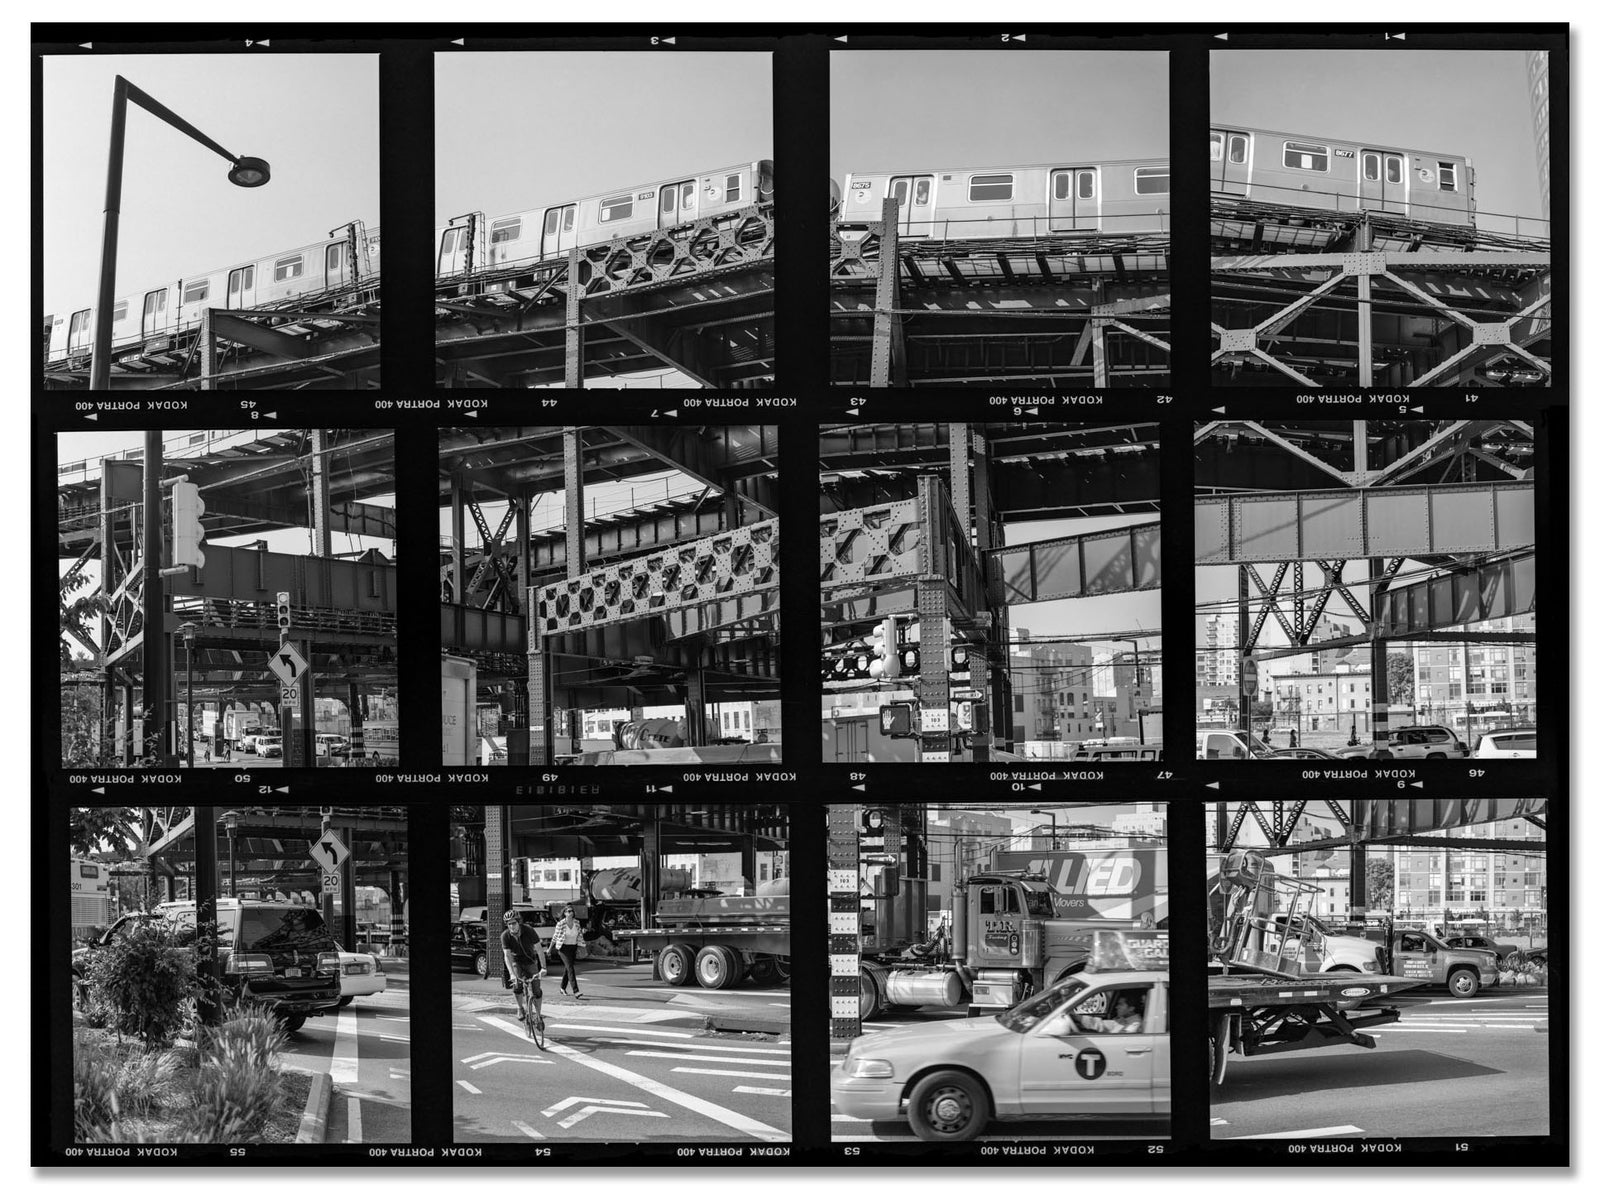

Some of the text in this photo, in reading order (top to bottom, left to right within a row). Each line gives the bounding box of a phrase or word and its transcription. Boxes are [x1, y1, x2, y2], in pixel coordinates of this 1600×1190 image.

[651, 37, 659, 45] 3
[1002, 34, 1009, 42] 2
[245, 39, 253, 47] 4
[542, 399, 557, 407] 44
[684, 399, 702, 407] 400
[756, 398, 796, 406] KODAK
[990, 396, 1102, 405] KODAK PORTRA 400
[1297, 395, 1409, 403] KODAK PORTRA 400
[76, 401, 187, 410] KODAK PORTRA 400
[396, 400, 440, 408] PORTRA
[448, 400, 487, 408] KODAK
[251, 411, 259, 419] 8
[1014, 407, 1021, 415] 6
[282, 688, 296, 699] 20
[683, 773, 796, 781] KODAK PORTRA 400
[850, 772, 866, 780] 48
[990, 772, 1008, 780] 400
[1012, 772, 1054, 780] PORTRA
[1157, 771, 1173, 779] 47
[1302, 770, 1415, 779] KODAK PORTRA 400
[1469, 769, 1485, 777] 46
[70, 775, 181, 783] KODAK PORTRA 400
[397, 774, 440, 782] PORTRA
[448, 774, 488, 782] KODAK
[1012, 783, 1025, 791] 10
[324, 876, 338, 886] 20
[1081, 1054, 1100, 1076] T
[844, 1147, 860, 1155] 53
[981, 1146, 1094, 1155] KODAK PORTRA 400
[1289, 1144, 1401, 1153] KODAK PORTRA 400
[1456, 1143, 1468, 1151] 51
[66, 1148, 177, 1156] KODAK PORTRA 400
[230, 1148, 245, 1156] 55
[390, 1148, 434, 1156] PORTRA
[442, 1148, 481, 1156] KODAK
[535, 1148, 551, 1156] 54
[677, 1148, 790, 1156] KODAK PORTRA 400
